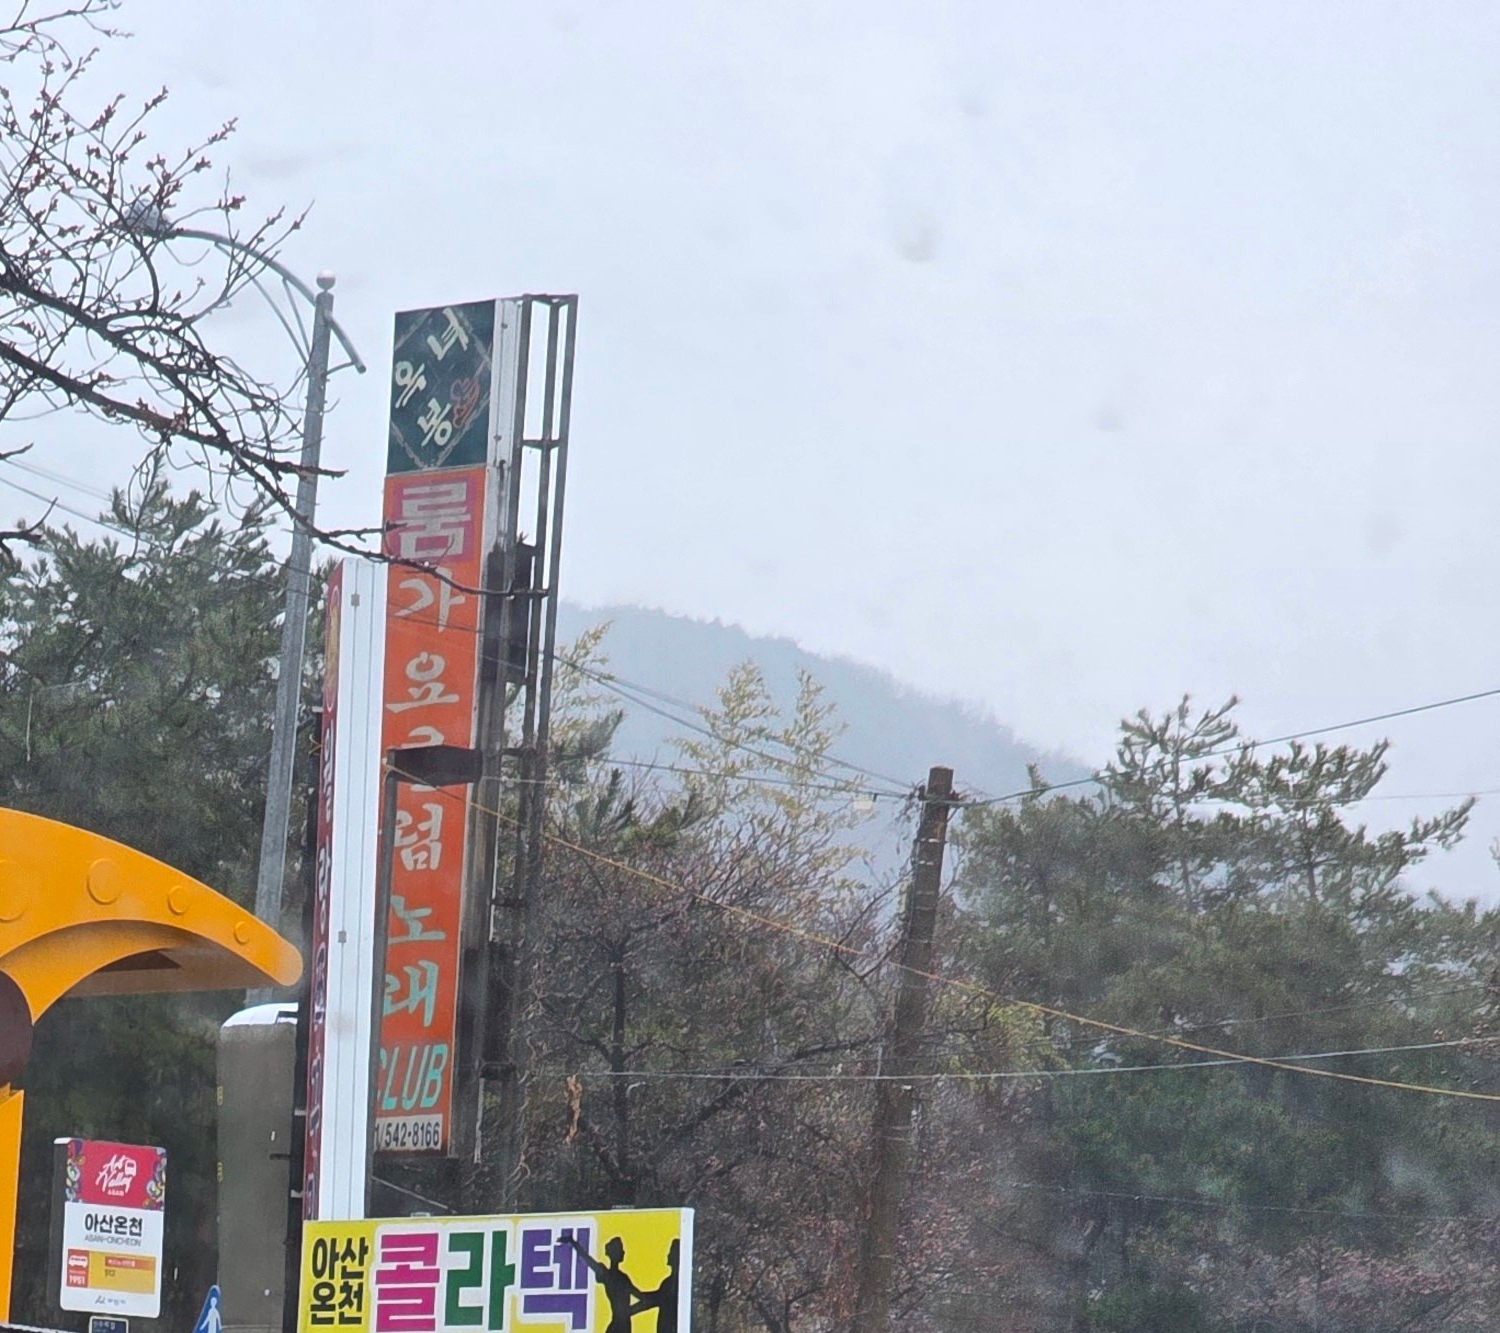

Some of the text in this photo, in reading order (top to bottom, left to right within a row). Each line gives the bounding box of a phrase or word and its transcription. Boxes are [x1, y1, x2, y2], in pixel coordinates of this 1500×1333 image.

[85, 1213, 143, 1237] 아산온천
[312, 1237, 368, 1280] 아산
[375, 1227, 591, 1333] 콜라텍
[310, 1281, 363, 1325] 온천
